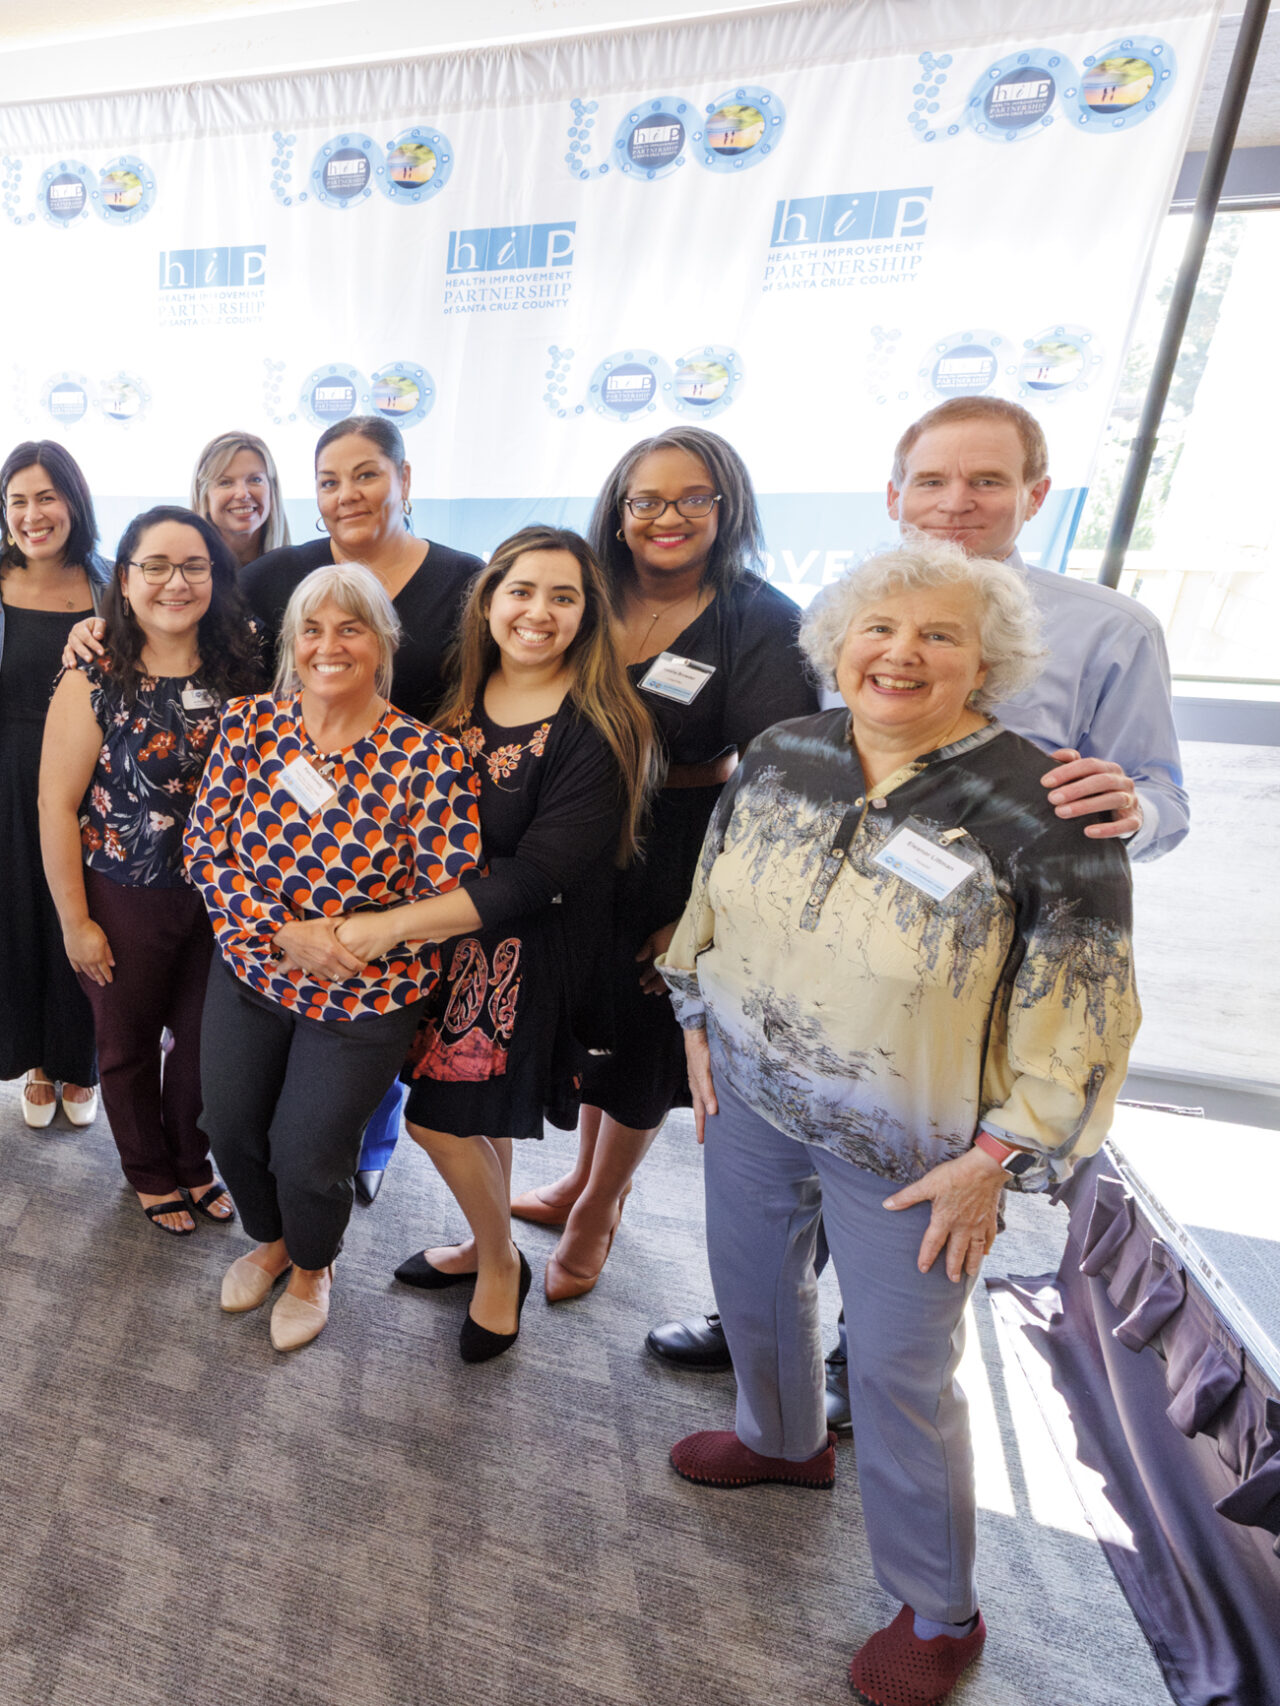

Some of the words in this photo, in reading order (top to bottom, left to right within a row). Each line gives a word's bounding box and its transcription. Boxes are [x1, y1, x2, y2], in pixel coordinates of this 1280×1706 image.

[774, 195, 931, 243] hip
[449, 228, 575, 271] hip
[768, 250, 818, 263] HEALTH
[823, 242, 924, 257] IMPROVEMENT
[161, 248, 266, 289] hip
[764, 256, 922, 280] PARTNERSHIP
[446, 277, 486, 288] HEALTH
[490, 271, 572, 284] IMPROVEMENT
[762, 282, 773, 292] of
[777, 280, 817, 290] SANTA
[821, 277, 855, 288] CRUZ
[860, 273, 918, 284] COUNTY
[200, 290, 264, 300] IMOVEMENT
[444, 283, 571, 304] PARTNERSHIP
[158, 301, 265, 317] PARTNRSHIP
[444, 306, 452, 314] of
[455, 304, 486, 314] SANTA
[489, 302, 519, 311] CRUZ
[522, 299, 569, 310] COUNTY
[169, 318, 198, 327] SANTA
